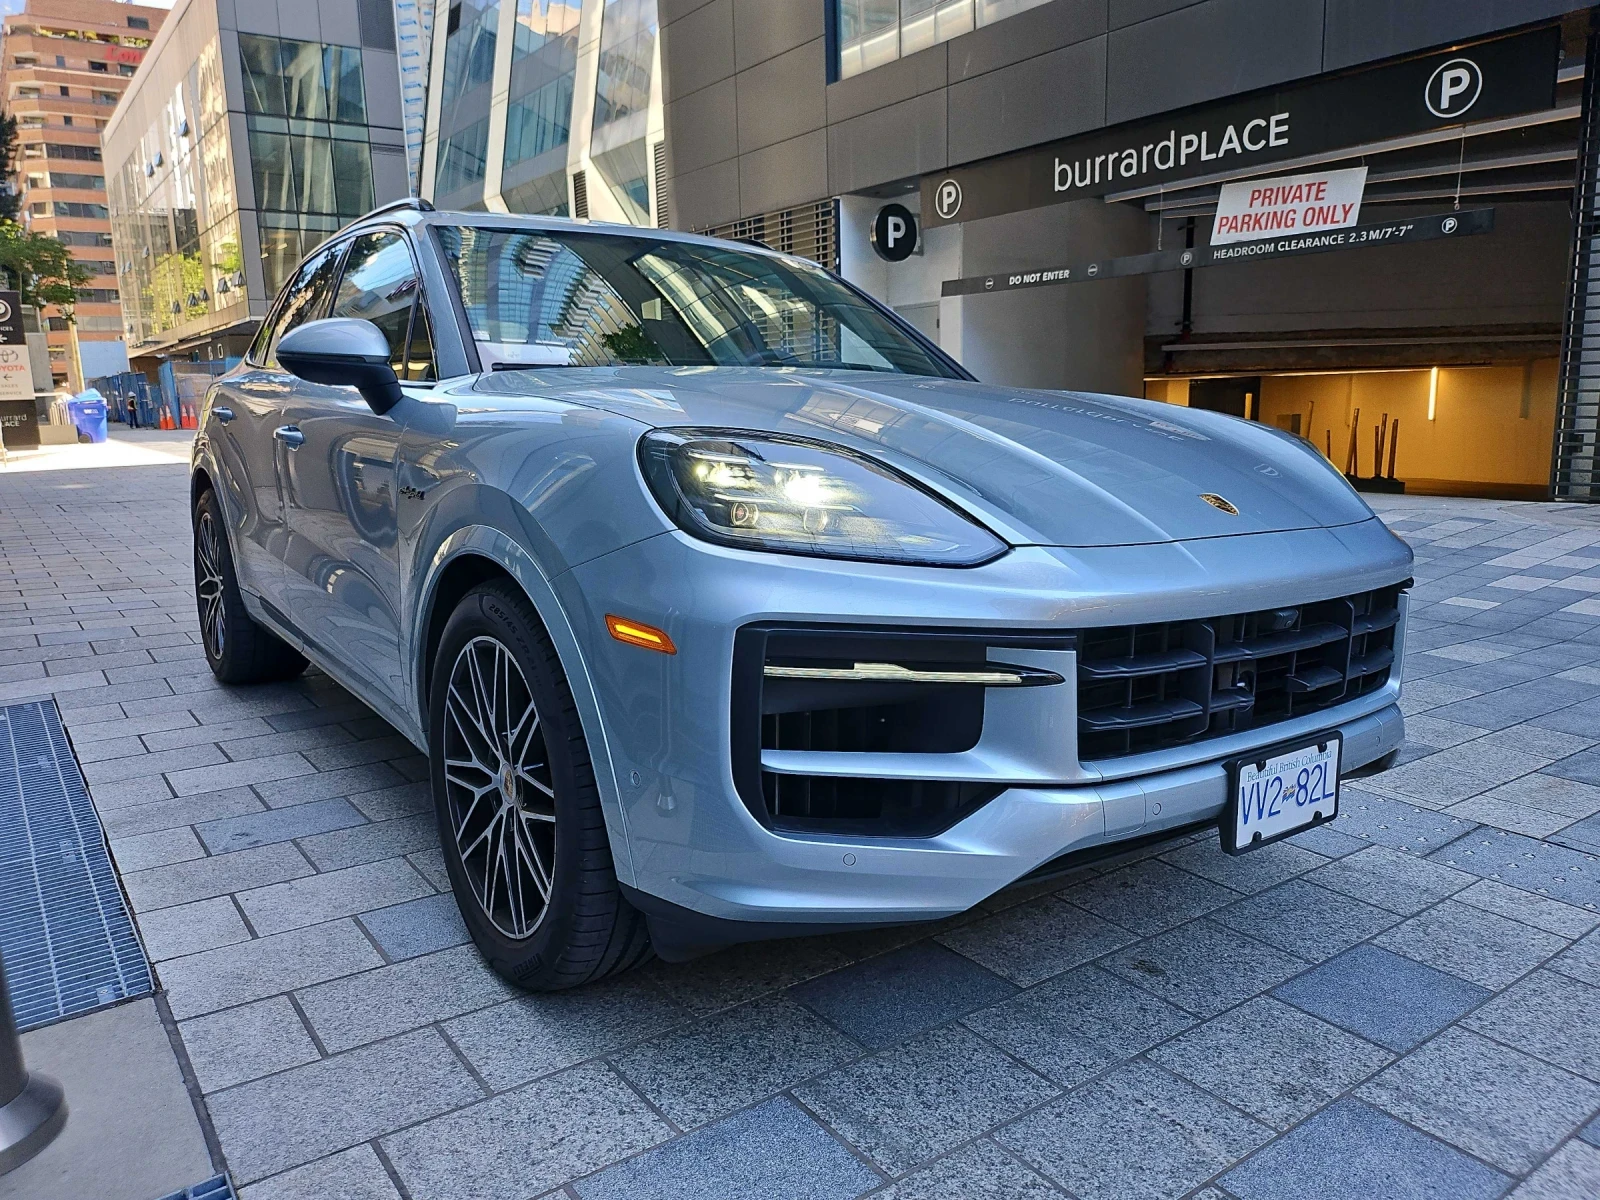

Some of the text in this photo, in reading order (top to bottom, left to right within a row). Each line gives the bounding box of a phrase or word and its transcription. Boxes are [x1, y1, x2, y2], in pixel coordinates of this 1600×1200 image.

[1054, 112, 1290, 192] burrardPLACE
[1249, 181, 1328, 208] PRIVATE
[887, 216, 906, 248] P
[1217, 203, 1354, 235] PARKING ONLY
[1213, 243, 1275, 260] HEADROOM
[1277, 233, 1345, 252] CLEARANCE
[1009, 269, 1070, 286] DO NOT ENTER
[1247, 750, 1332, 782] Beautiful British Columbia
[1241, 761, 1335, 825] VV2 82L
